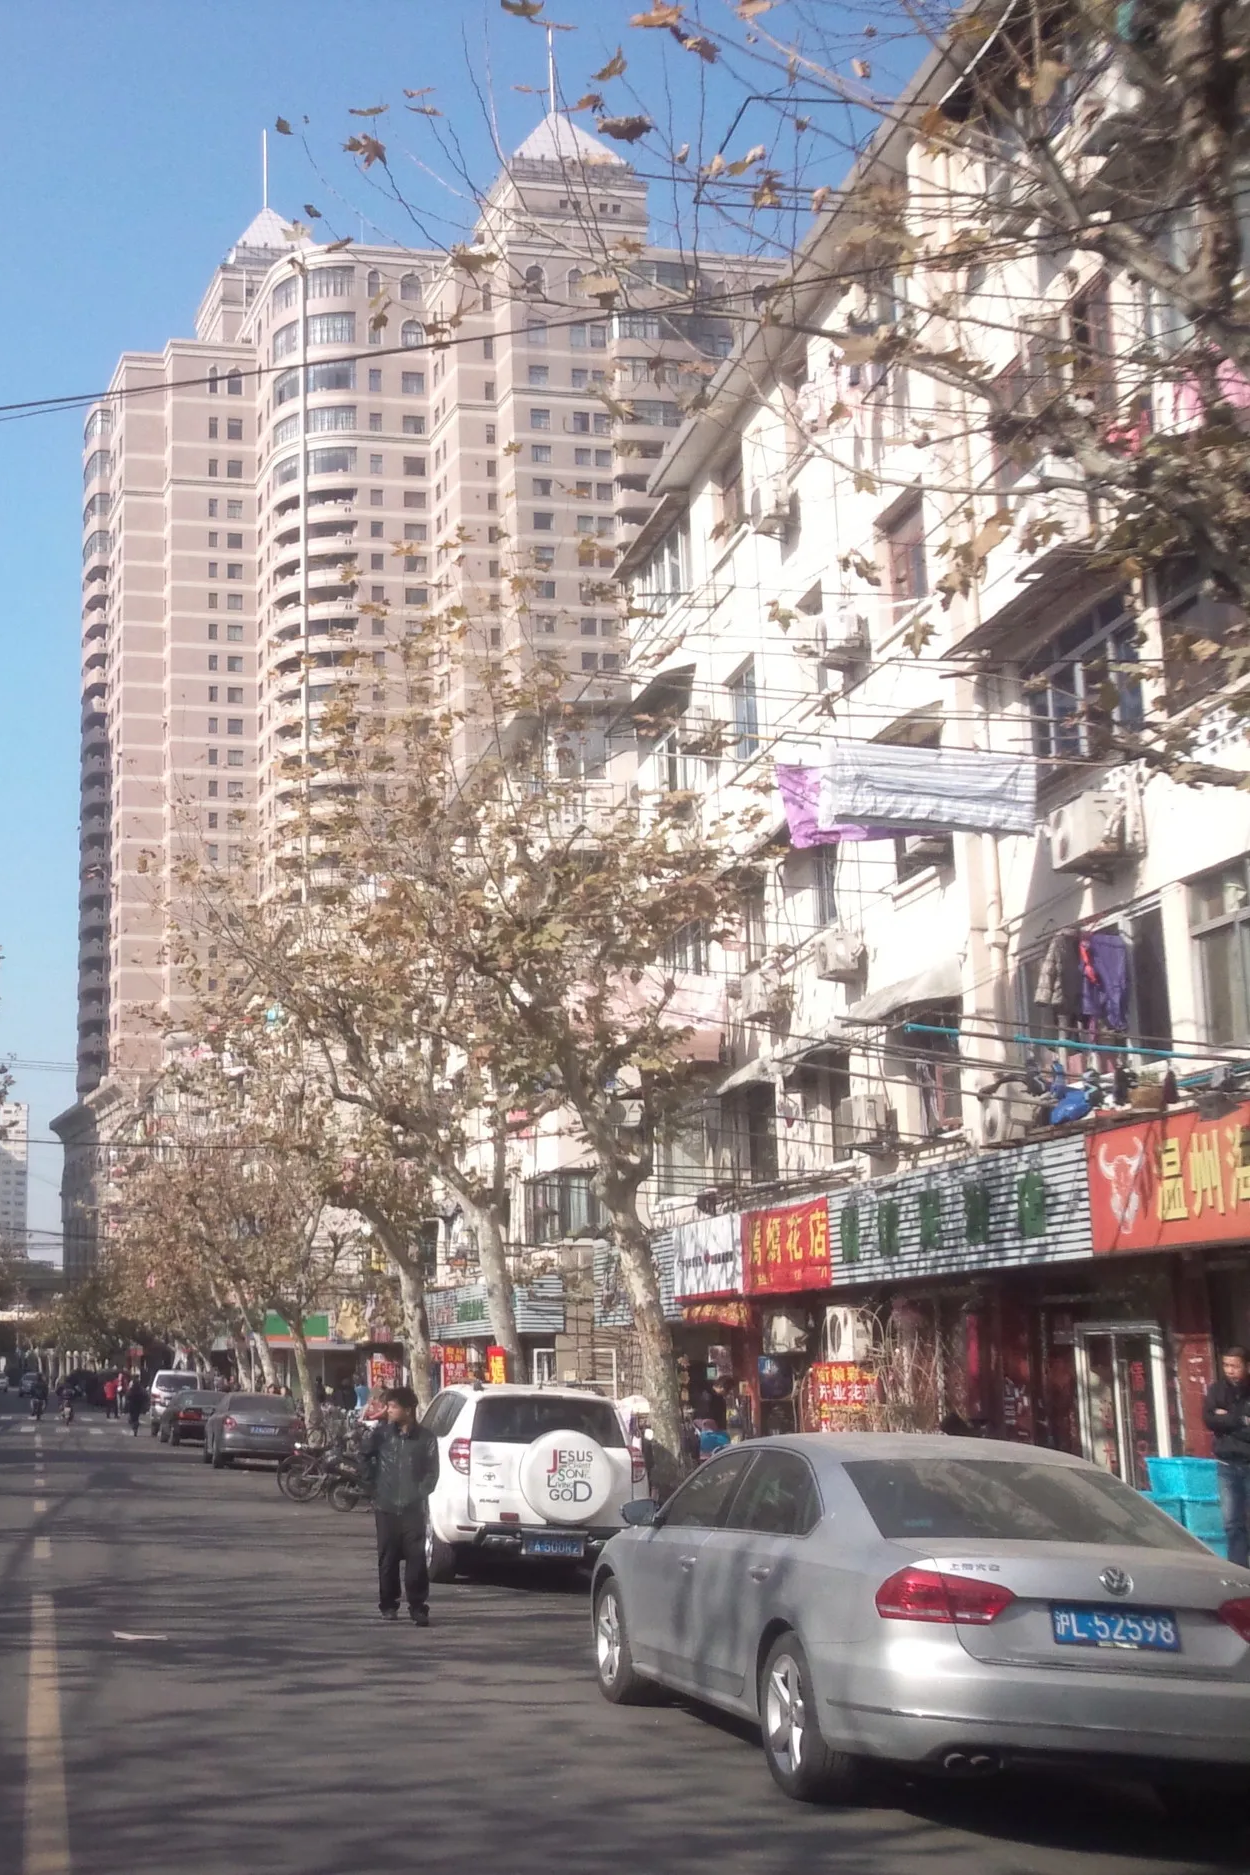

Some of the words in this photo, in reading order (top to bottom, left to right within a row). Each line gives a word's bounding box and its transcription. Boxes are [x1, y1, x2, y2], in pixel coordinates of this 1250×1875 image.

[546, 1449, 593, 1473] JESUS
[558, 1469, 584, 1481] SON
[549, 1480, 593, 1502] GOD
